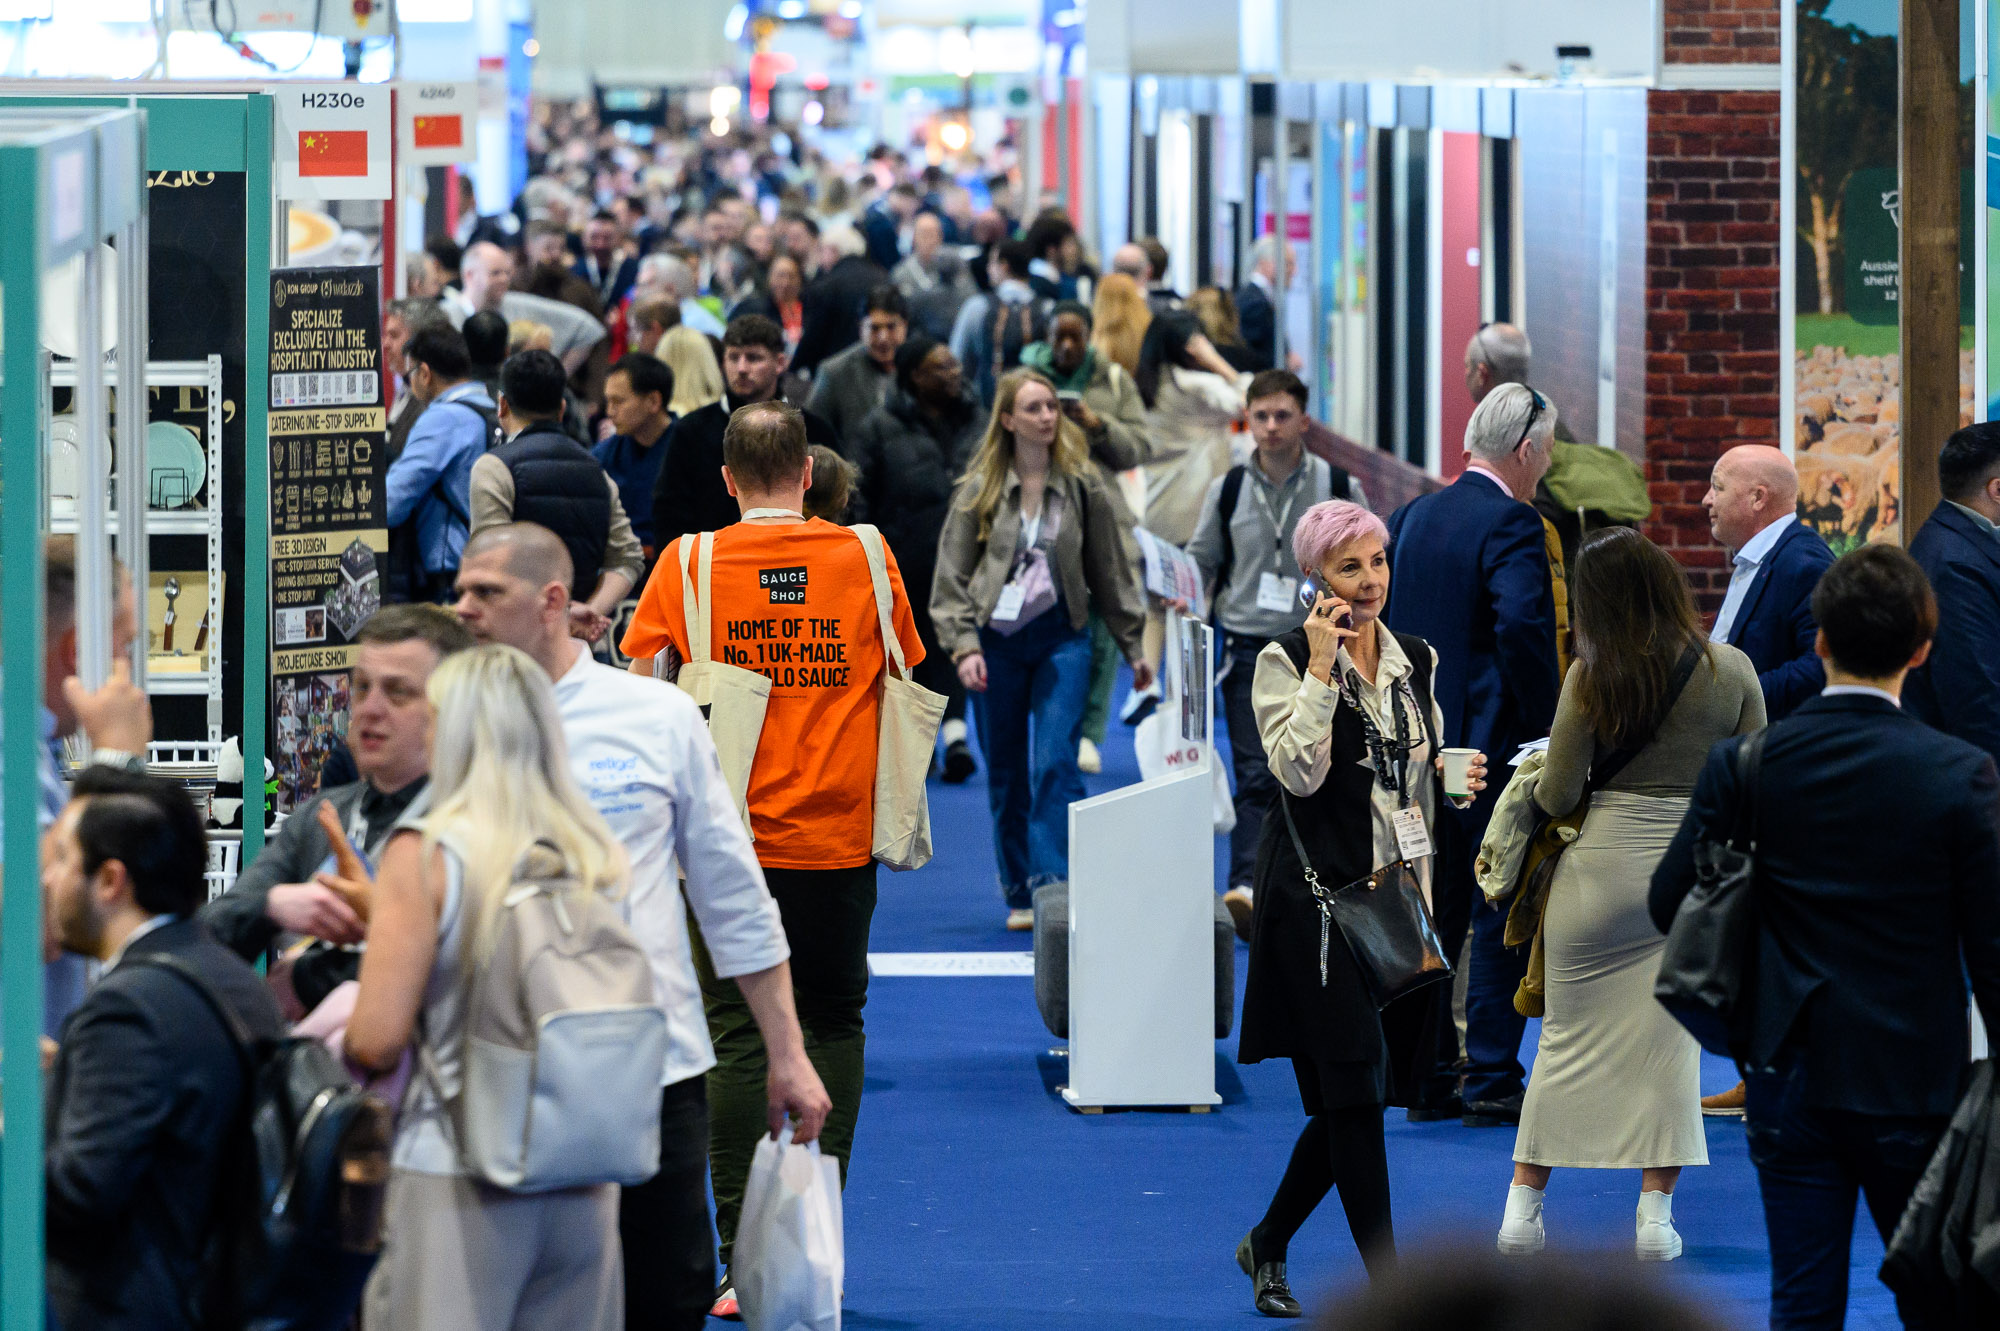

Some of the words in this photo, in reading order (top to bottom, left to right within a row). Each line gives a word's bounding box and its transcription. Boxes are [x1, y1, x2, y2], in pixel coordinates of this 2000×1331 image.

[302, 93, 365, 108] H230e
[287, 284, 299, 294] RON
[300, 283, 318, 294] GROUP
[1863, 274, 1893, 286] shelf
[291, 309, 343, 329] SPECIALIZE
[274, 330, 334, 351] EXCLUSIVELY
[335, 330, 344, 348] IN
[346, 329, 366, 348] THE
[271, 351, 327, 371] HOSPITALITY
[328, 349, 377, 369] INDUSTRY
[272, 415, 305, 432] CATERING
[306, 413, 343, 431] ONE-STOP
[344, 412, 377, 429] SUPPLY
[274, 539, 290, 556] FREE
[291, 539, 303, 555] 3D
[303, 537, 327, 554] DESIGN
[317, 557, 341, 570] SERVICE
[323, 572, 339, 585] COST
[760, 571, 807, 585] SAUCE
[277, 591, 287, 604] ONE
[288, 590, 302, 603] STOP
[770, 591, 805, 601] SHOP
[727, 619, 777, 641] HOME
[781, 618, 804, 638] OF
[809, 618, 841, 639] THE
[277, 653, 308, 671] PROJECT
[308, 652, 323, 669] CASE
[325, 651, 348, 667] SHOW
[723, 645, 753, 664] No.
[756, 643, 764, 663] 1
[769, 643, 847, 663] UK-MADE
[798, 666, 850, 688] SAUCE
